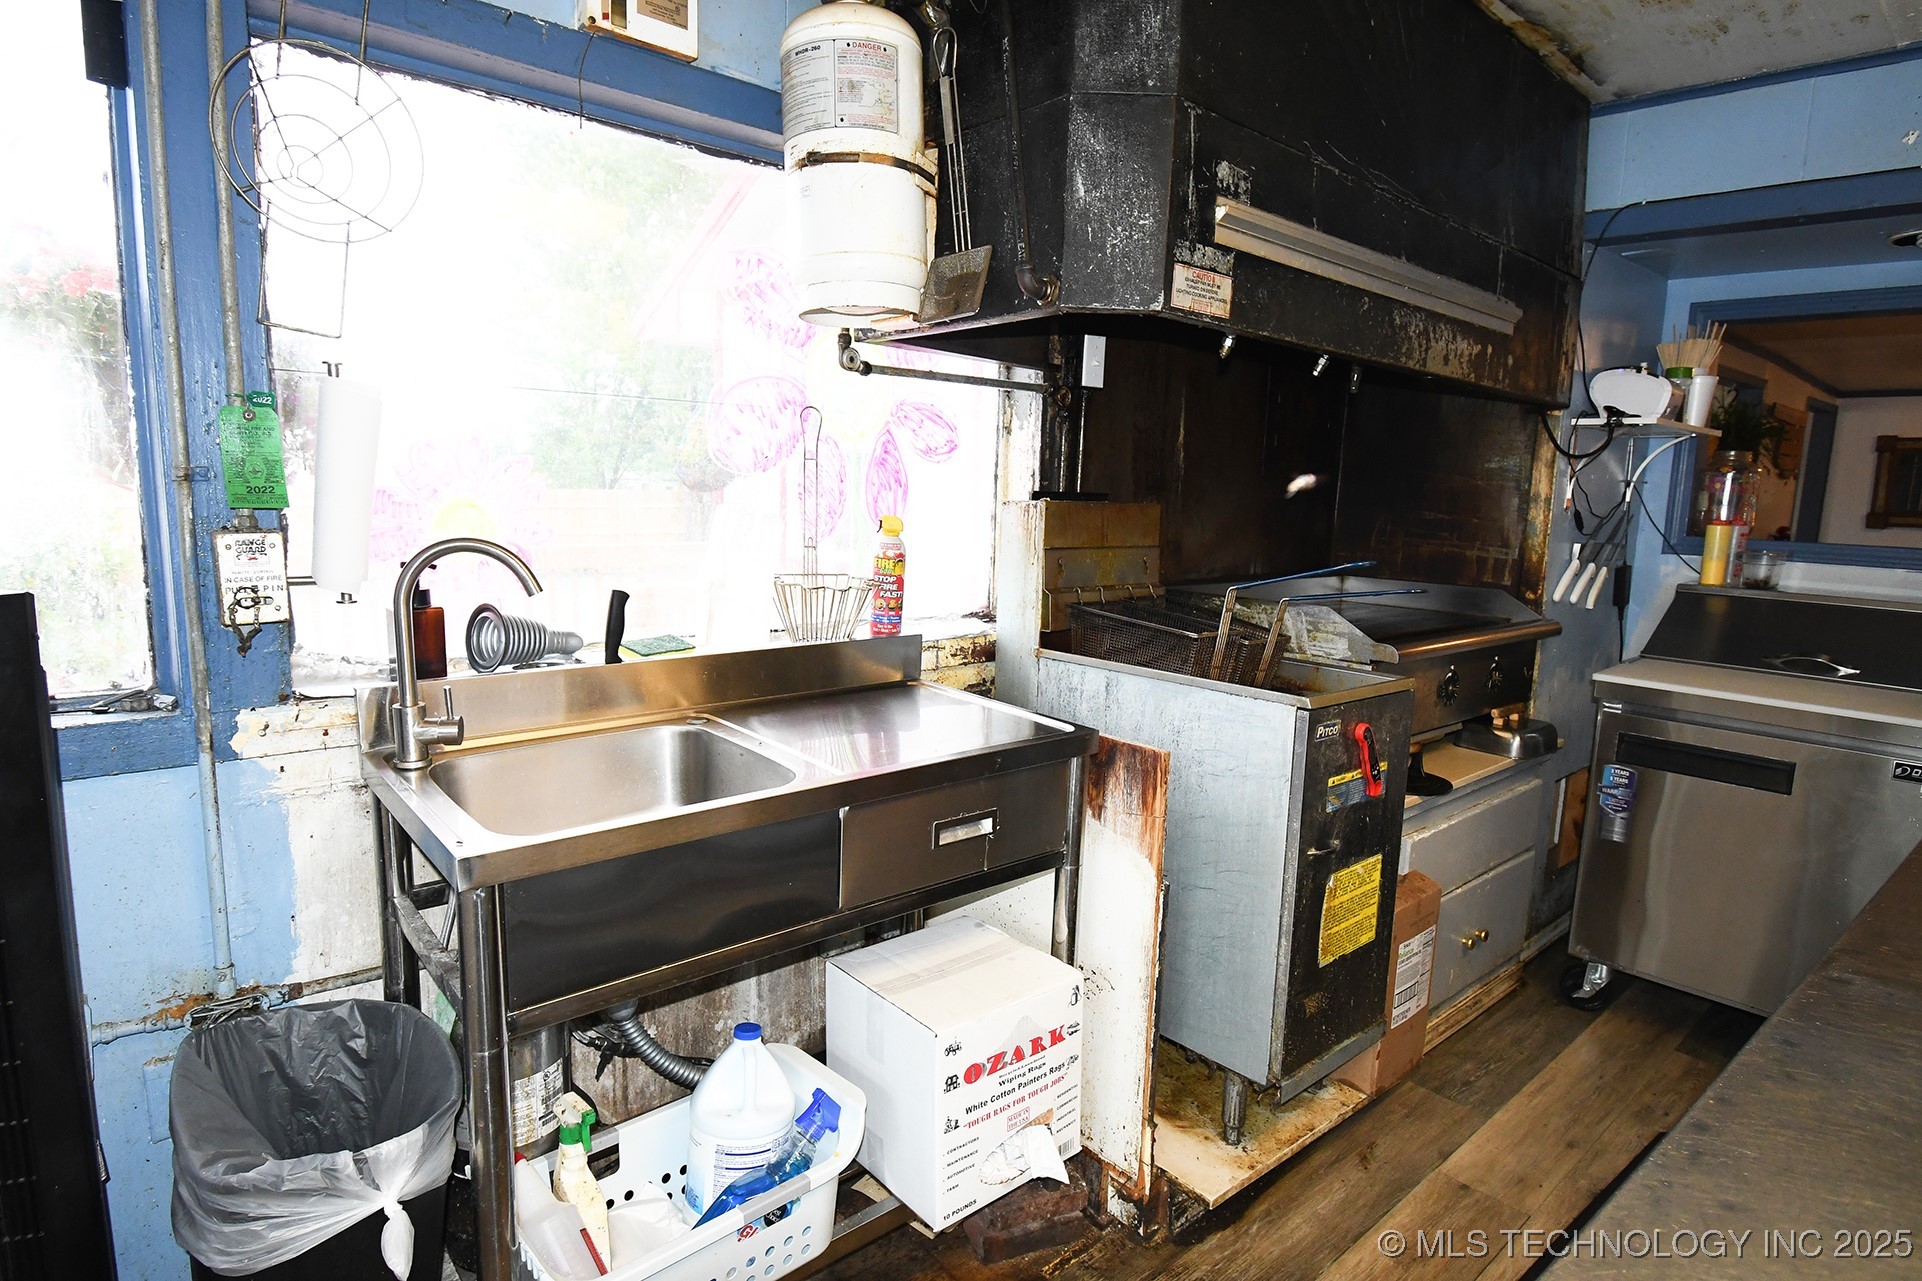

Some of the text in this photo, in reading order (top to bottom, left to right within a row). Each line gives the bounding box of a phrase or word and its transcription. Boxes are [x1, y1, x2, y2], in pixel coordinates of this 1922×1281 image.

[852, 42, 881, 51] DANGER
[1192, 271, 1216, 283] CAUTION
[253, 396, 272, 405] 2022
[246, 485, 275, 494] 2022
[235, 539, 266, 547] RANGE
[234, 575, 254, 583] CASE
[873, 575, 896, 583] STOP
[263, 584, 283, 592] PIN
[963, 1024, 1066, 1085] OZARK
[999, 1062, 1047, 1087] Wiping Rags
[965, 1062, 1065, 1115] White Cotton Painters Rags
[993, 1103, 1011, 1117] RAGS
[1012, 1095, 1026, 1107] FOR
[1028, 1083, 1049, 1099] TOUGH
[1057, 1095, 1078, 1110] COMMERCIAL
[1008, 1111, 1021, 1122] MADE
[946, 1137, 980, 1155] CONTRACTORS
[946, 1150, 979, 1168] MAINTENANCE
[946, 1163, 976, 1180] AUTOMOTIVE
[946, 1184, 959, 1193] FARM
[943, 1199, 977, 1221] 10 POUNDS
